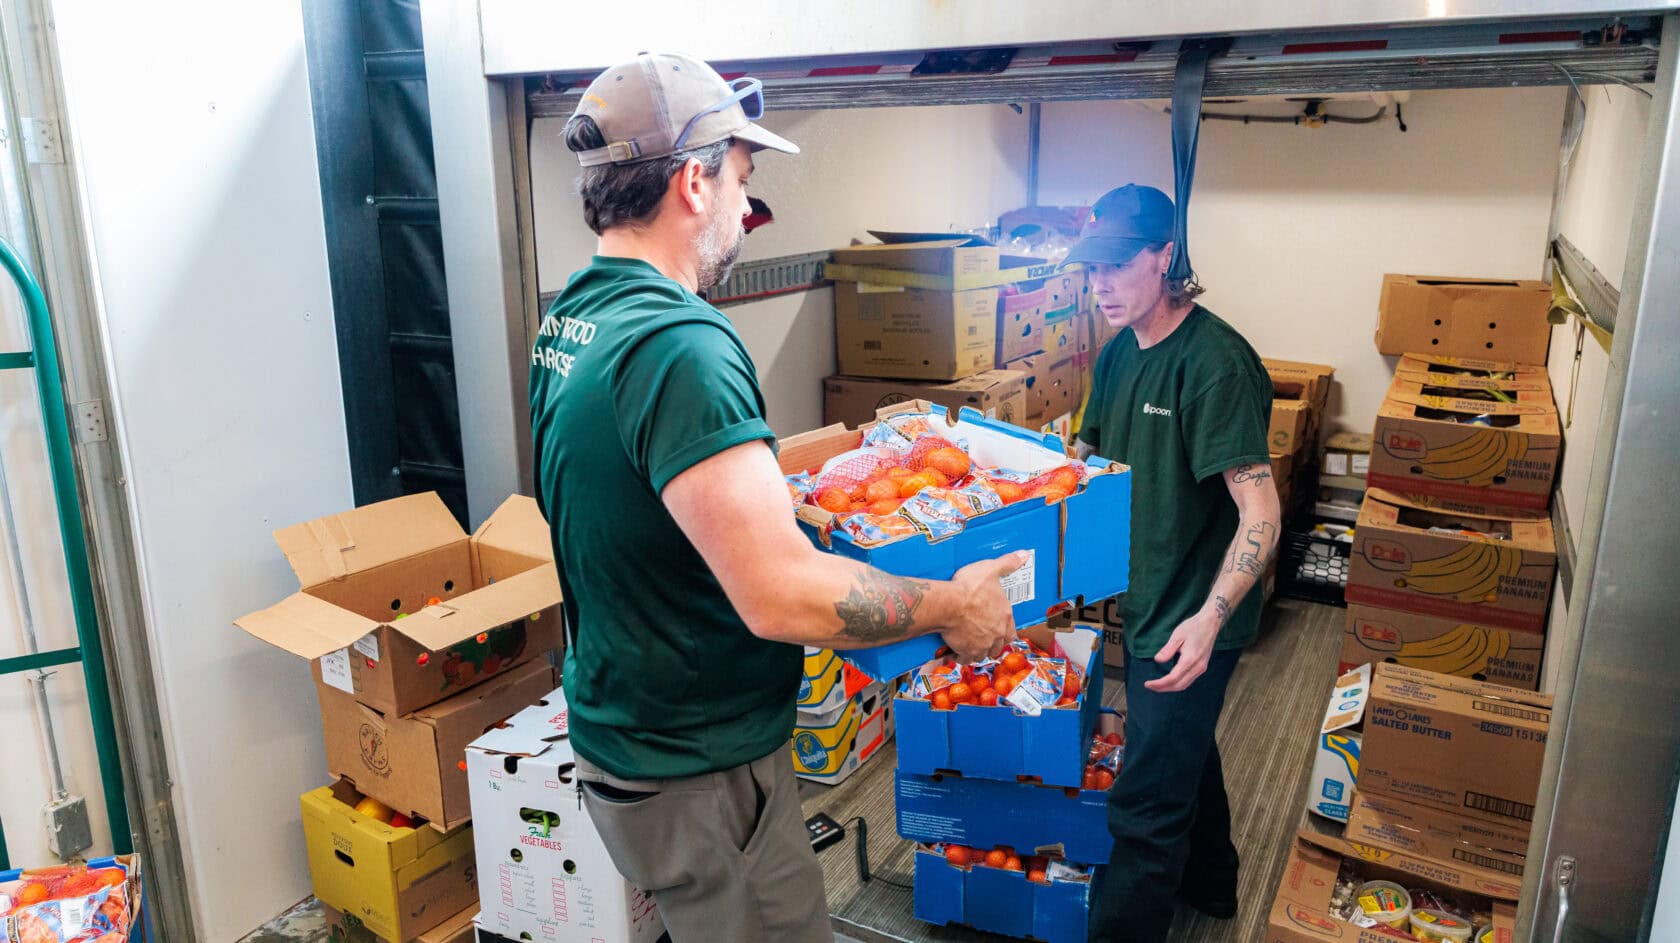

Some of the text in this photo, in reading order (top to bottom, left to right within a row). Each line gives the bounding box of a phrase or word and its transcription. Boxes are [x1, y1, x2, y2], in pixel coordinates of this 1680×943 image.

[1389, 434, 1422, 450] Dole
[1507, 459, 1551, 472] PREMIUM
[1505, 468, 1550, 482] BANANAS
[1371, 544, 1406, 562] Dole
[1499, 575, 1547, 591] PREMIUM
[1362, 624, 1398, 642] Dole
[1487, 656, 1535, 672] PREMIUM
[1485, 667, 1533, 683] BANANAS
[1372, 705, 1394, 718] LAND
[1408, 711, 1432, 725] LAKES
[1371, 716, 1452, 740] SALTED BUTTER
[519, 834, 563, 851] VEGETABLES
